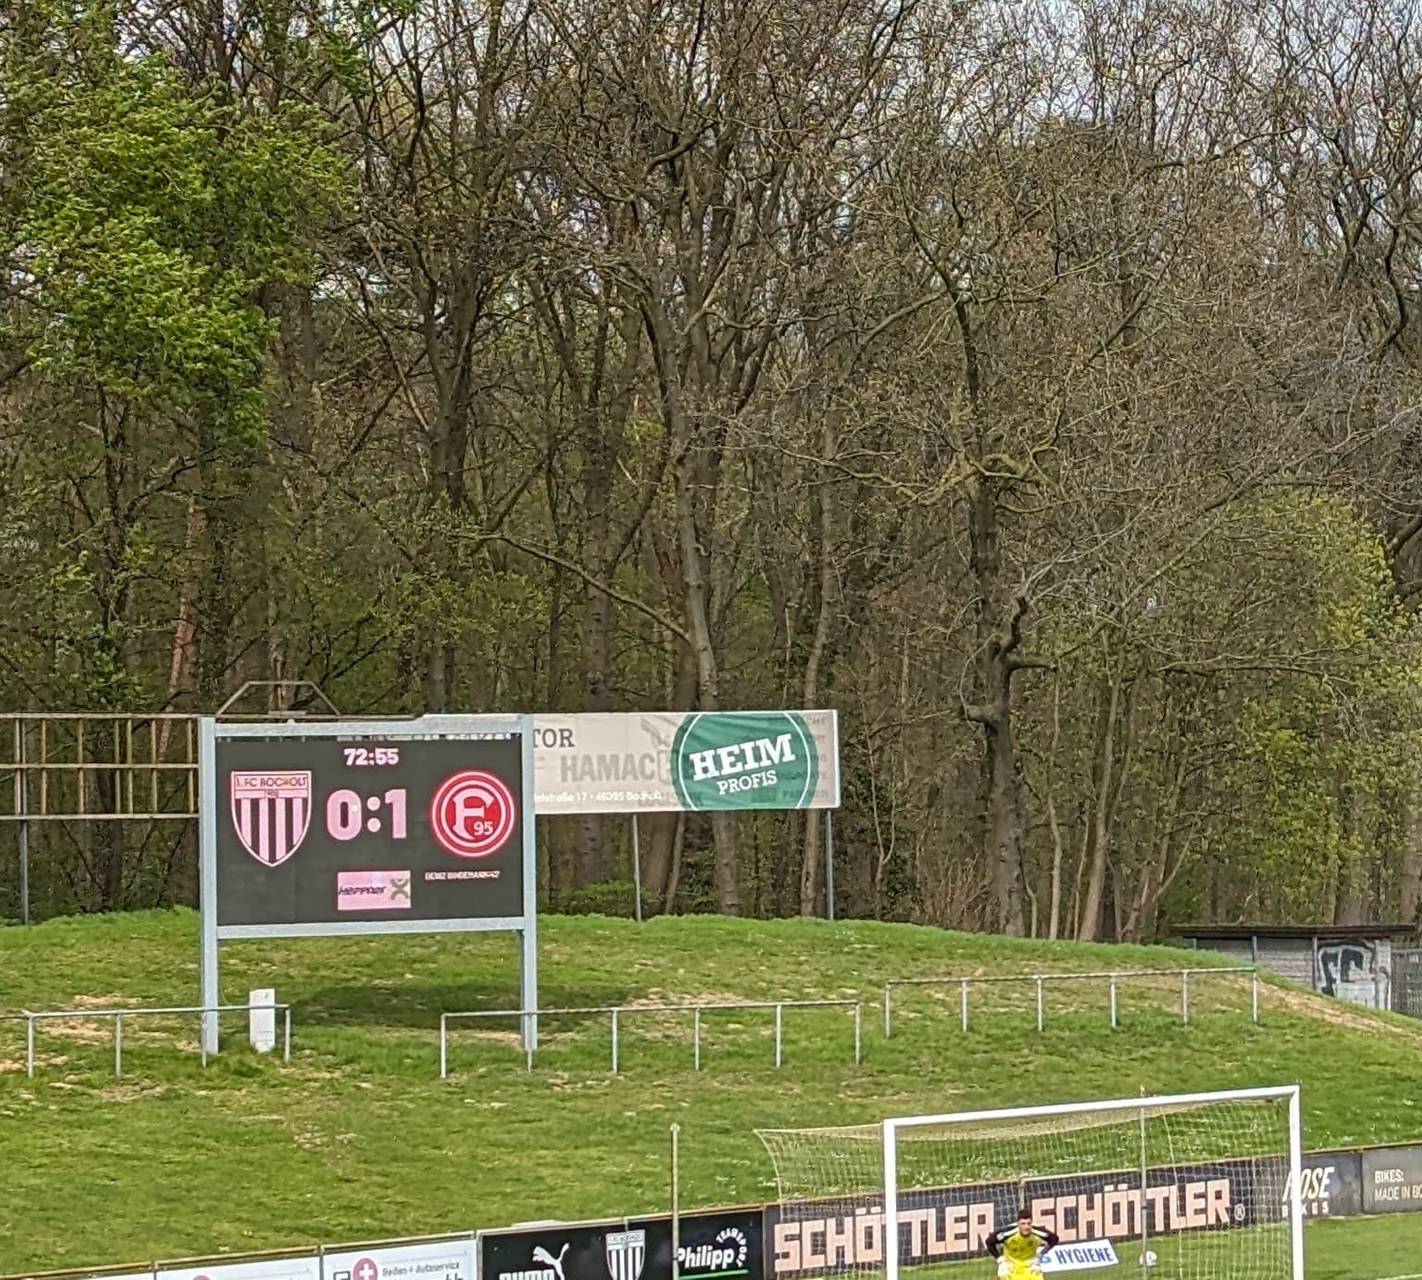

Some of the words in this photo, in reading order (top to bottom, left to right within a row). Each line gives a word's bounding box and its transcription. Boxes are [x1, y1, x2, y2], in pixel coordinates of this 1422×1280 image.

[343, 748, 400, 766] 72:55
[689, 733, 797, 781] HEIM
[244, 777, 257, 788] FC
[716, 769, 778, 795] PROFIS
[576, 791, 587, 801] 17
[326, 789, 408, 841] 0:1
[452, 787, 496, 841] F
[473, 821, 494, 836] 95
[1374, 1168, 1404, 1184] BIKES:
[1374, 1187, 1399, 1201] MADE
[1400, 1186, 1411, 1199] IN
[1031, 1178, 1230, 1244] SCHÖTTLER
[1281, 1200, 1329, 1218] BKES
[774, 1201, 997, 1273] SCHÖTLER
[678, 1244, 735, 1271] Philipp
[1055, 1247, 1114, 1265] HYGIENE
